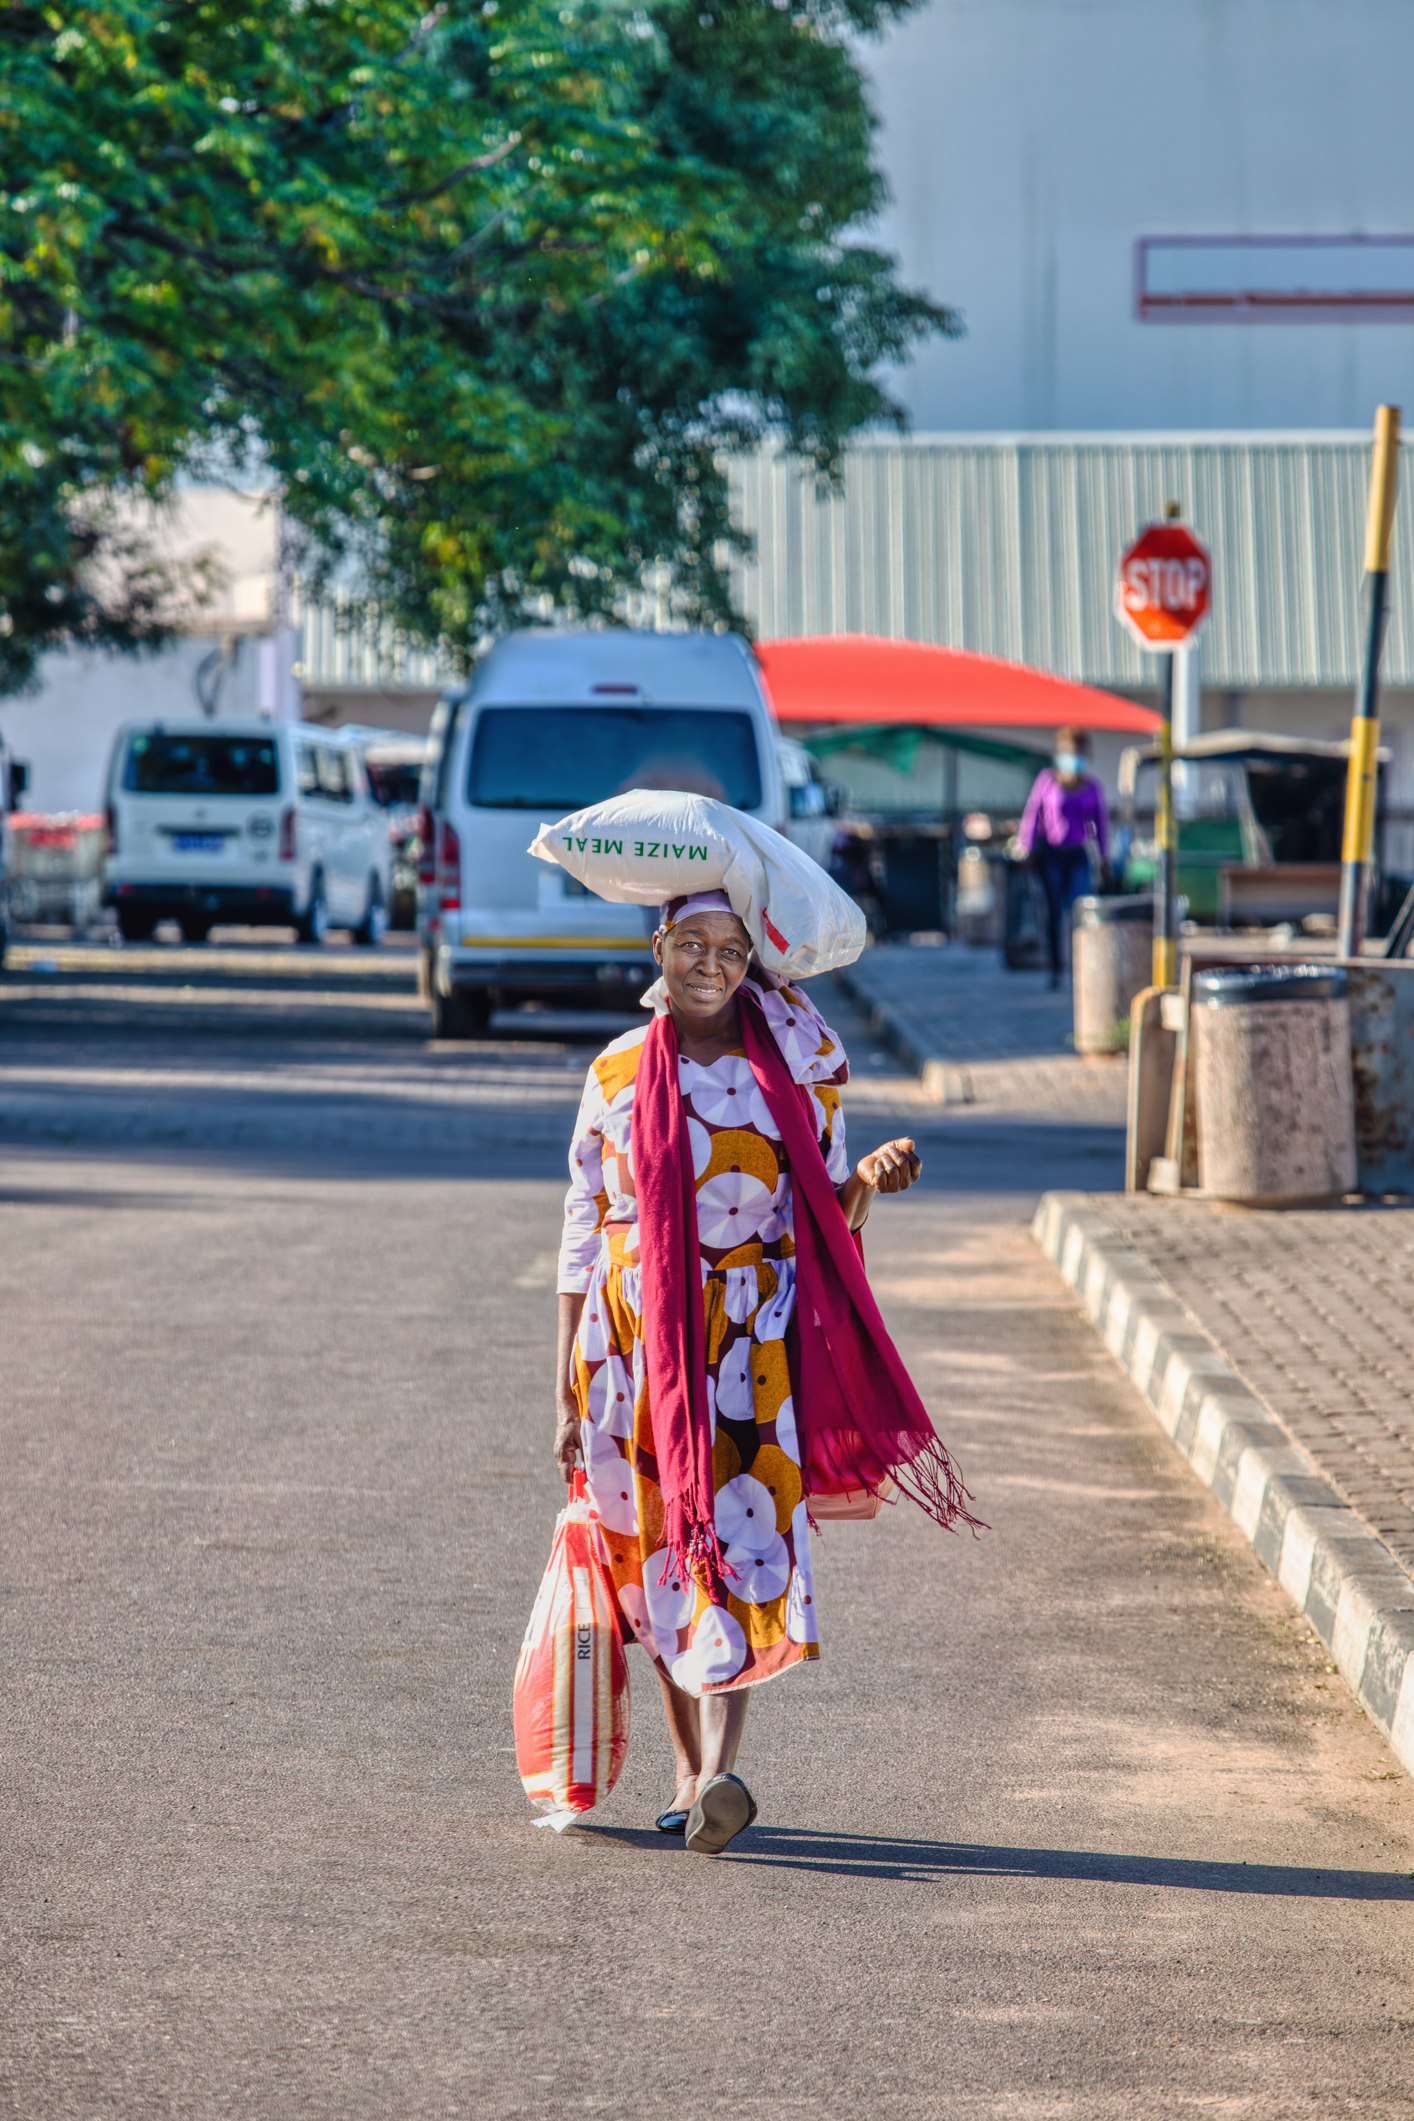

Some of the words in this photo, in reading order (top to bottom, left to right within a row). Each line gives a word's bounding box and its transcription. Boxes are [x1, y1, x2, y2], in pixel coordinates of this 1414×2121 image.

[1127, 557, 1207, 612] STOP
[562, 837, 623, 855] MEAL
[633, 841, 708, 861] MAIZE
[577, 1622, 591, 1660] RICE
